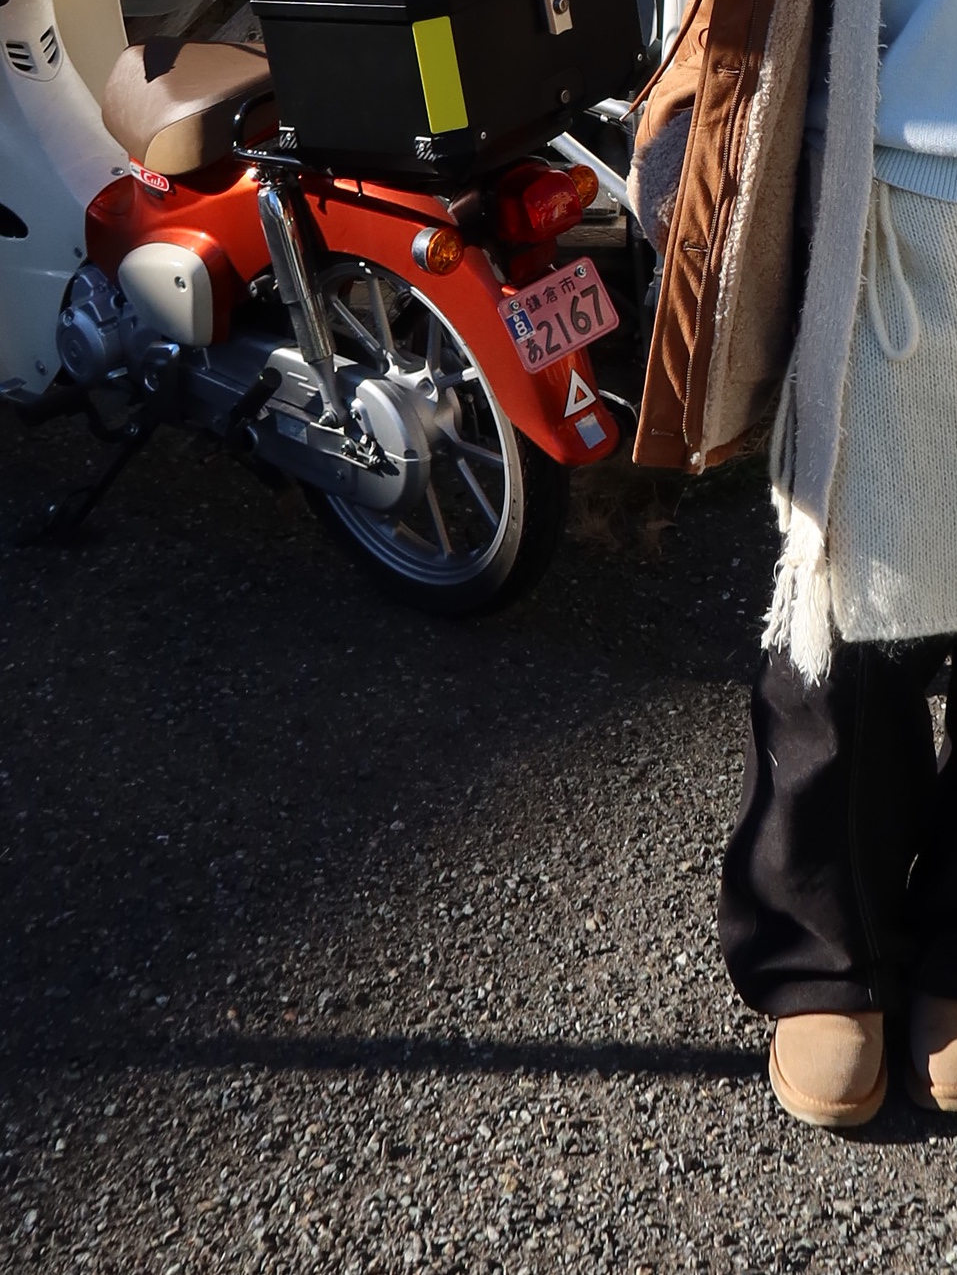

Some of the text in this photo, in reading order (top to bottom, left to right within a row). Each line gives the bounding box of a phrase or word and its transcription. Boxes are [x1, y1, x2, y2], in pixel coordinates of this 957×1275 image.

[526, 276, 576, 314] 鎌倉市
[536, 284, 604, 355] 2167
